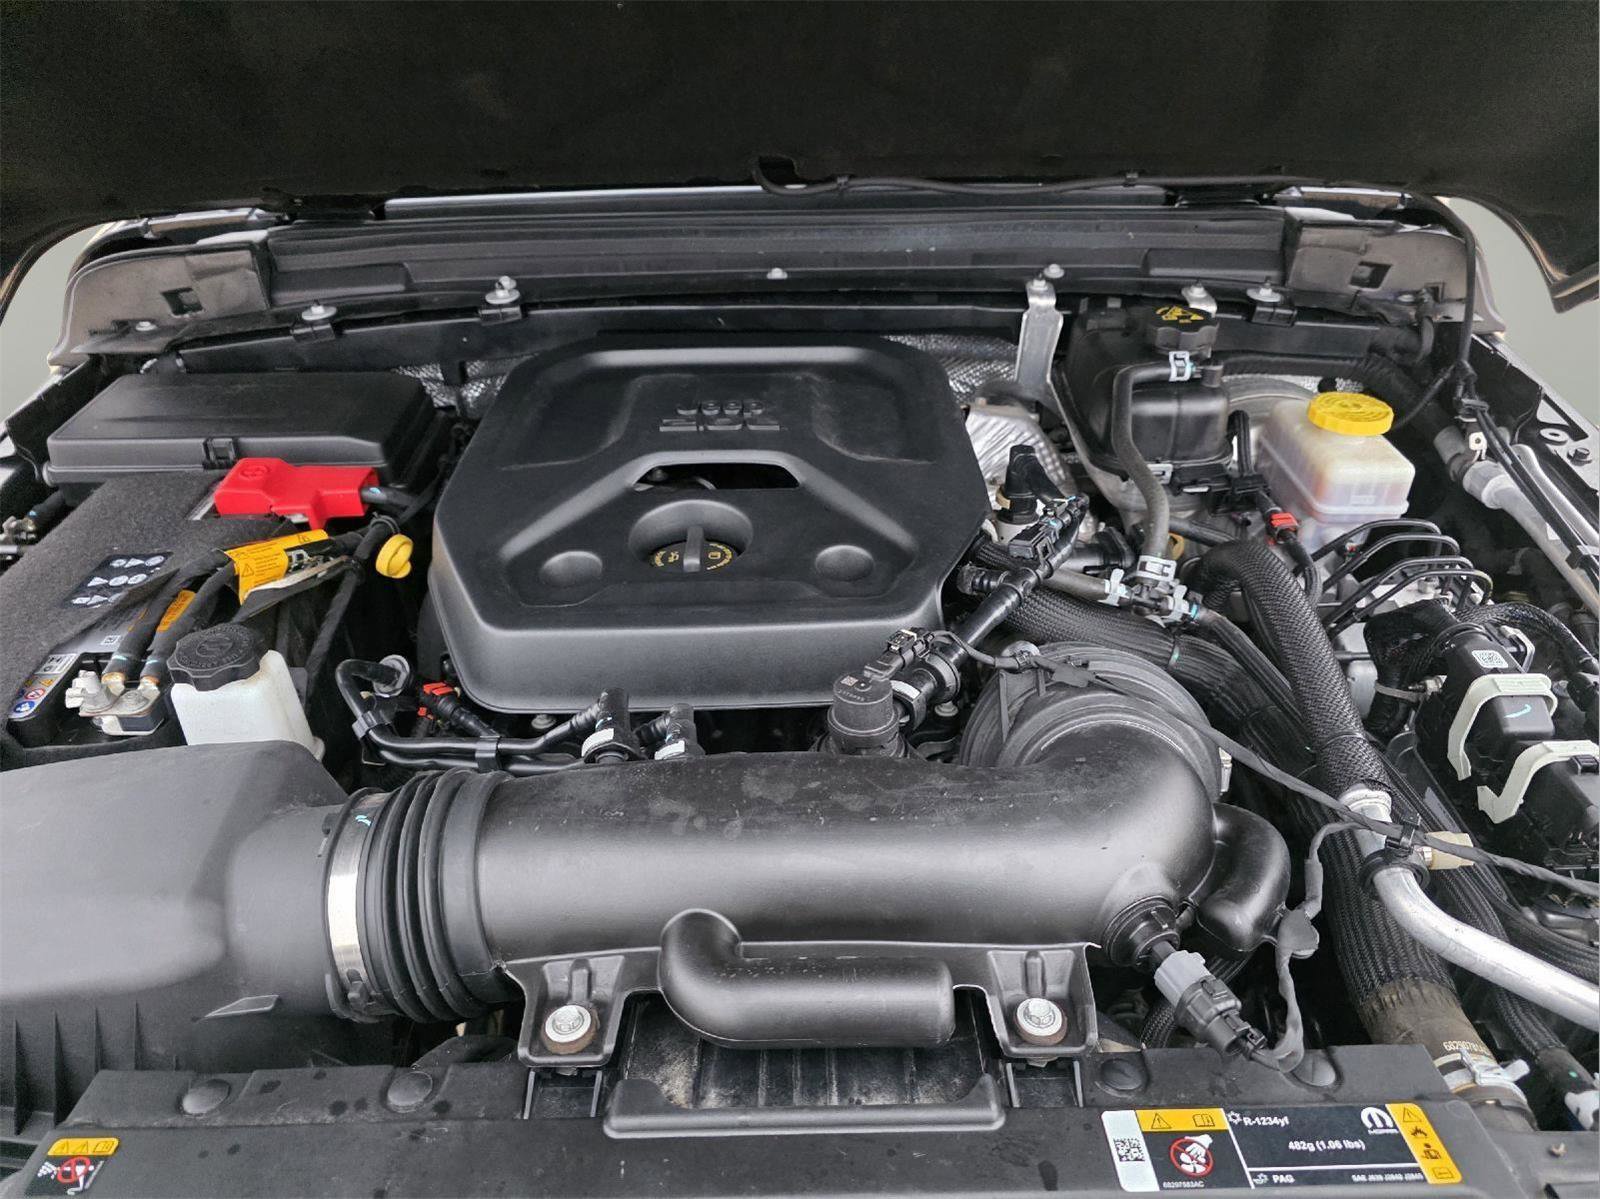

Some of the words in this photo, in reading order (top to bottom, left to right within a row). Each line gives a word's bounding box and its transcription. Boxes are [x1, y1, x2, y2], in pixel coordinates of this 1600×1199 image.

[1243, 1116, 1289, 1128] R-1234yf
[1288, 1140, 1315, 1152] 482g
[1271, 1174, 1296, 1184] PAG
